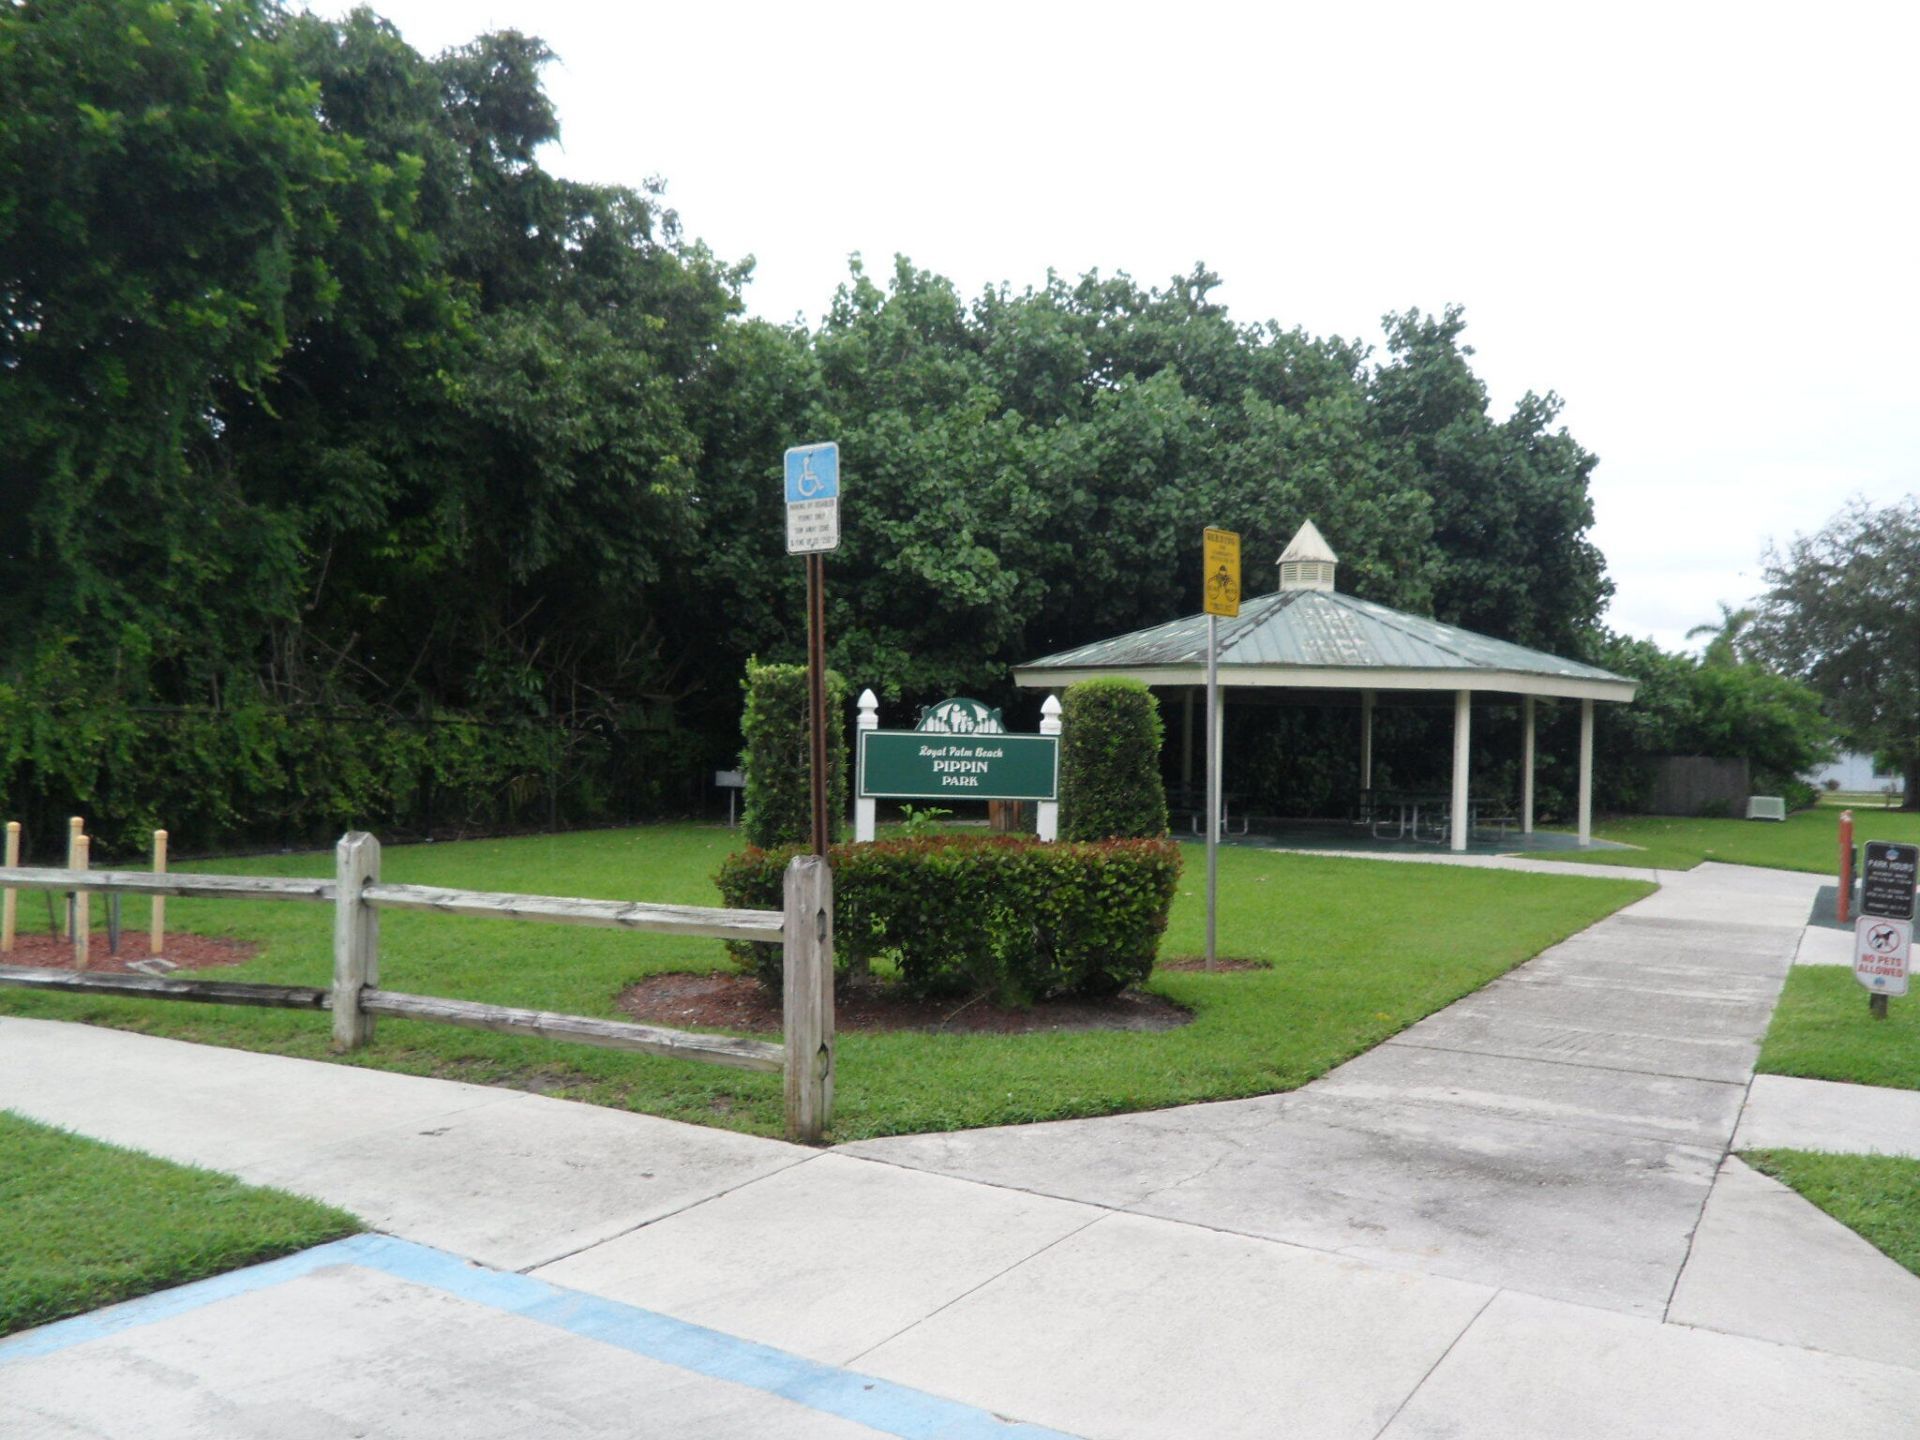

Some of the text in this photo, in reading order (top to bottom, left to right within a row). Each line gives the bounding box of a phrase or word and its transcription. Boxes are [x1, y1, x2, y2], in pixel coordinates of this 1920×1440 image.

[919, 745, 1004, 758] Royal Palm Beach
[933, 760, 989, 773] PIPPIN
[941, 775, 979, 787] PARK
[1867, 860, 1888, 869] PARK
[1861, 954, 1902, 967] NO PETS
[1857, 963, 1904, 978] ALLOWED
